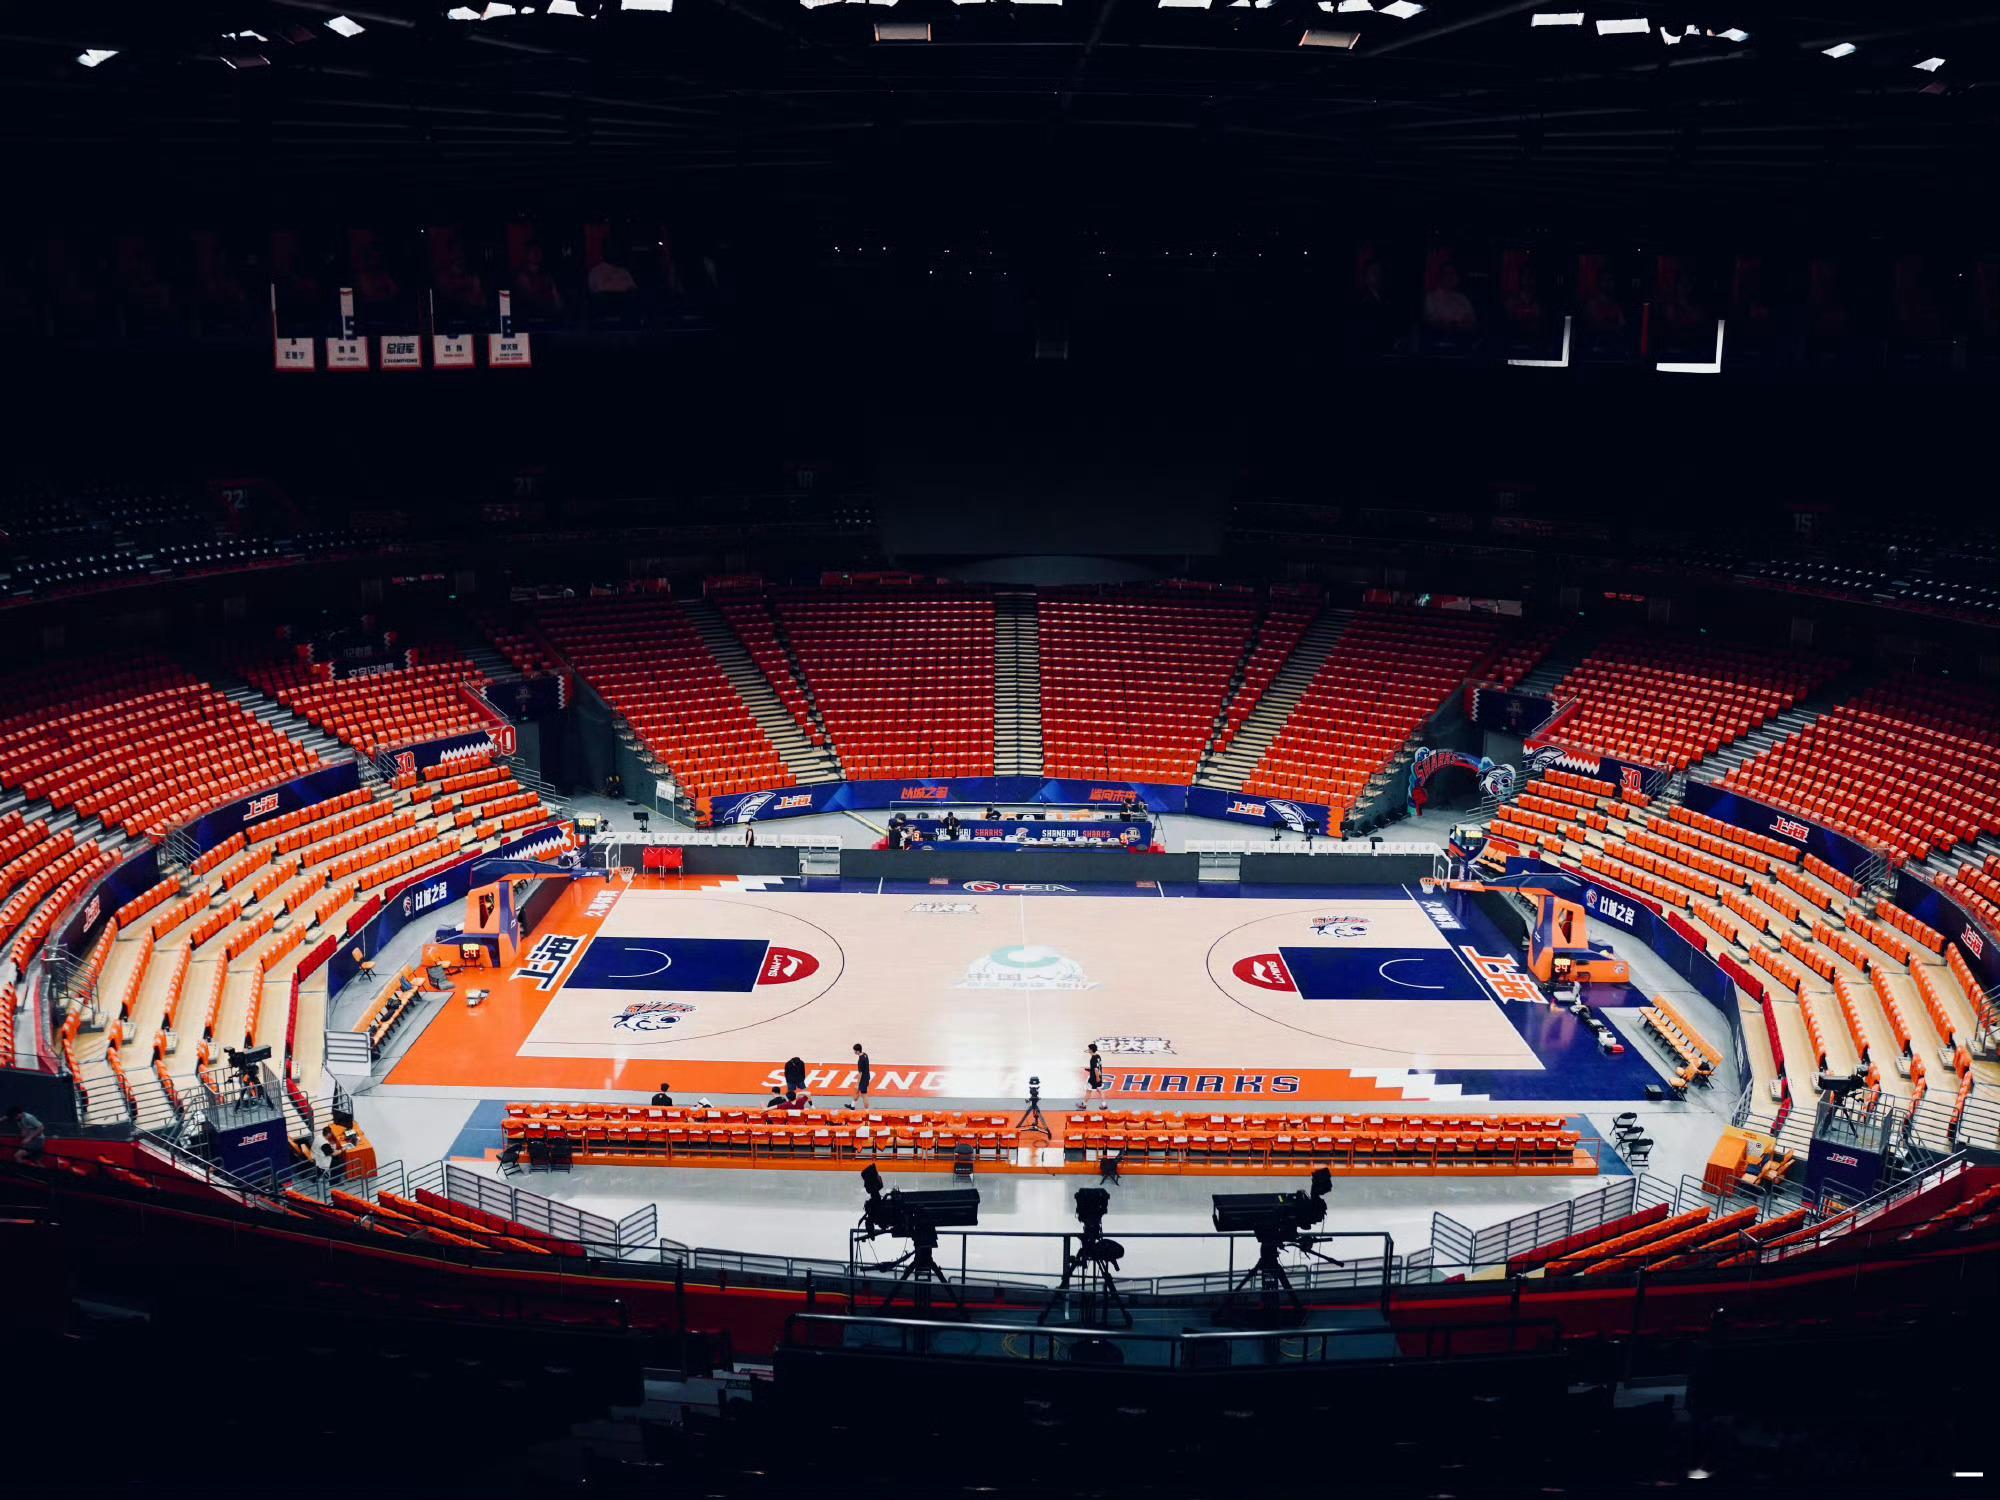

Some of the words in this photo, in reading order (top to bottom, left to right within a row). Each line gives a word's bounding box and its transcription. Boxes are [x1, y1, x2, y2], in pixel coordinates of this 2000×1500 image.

[485, 725, 517, 758] 30
[395, 751, 416, 775] 30
[1414, 750, 1459, 780] SHARKS
[1620, 765, 1642, 791] 30
[243, 793, 279, 821] 上海
[774, 794, 813, 810] 上海
[1226, 800, 1266, 817] 上海
[935, 828, 971, 838] SHAHAI
[975, 828, 1004, 837] SHARKS
[1042, 829, 1079, 838] SHANGHAI
[1082, 829, 1111, 838] SHARKS
[1769, 816, 1809, 843] 上海
[415, 881, 447, 911] 以城之名
[83, 895, 101, 933] 上海
[1599, 895, 1636, 927] 以城之名
[463, 949, 477, 959] 24
[1961, 923, 1984, 960] 上海
[508, 932, 588, 992] 上海
[1458, 945, 1549, 1005] 上海
[1554, 964, 1568, 973] 24
[238, 1131, 269, 1147] 上海
[1826, 1152, 1859, 1167] 上海
